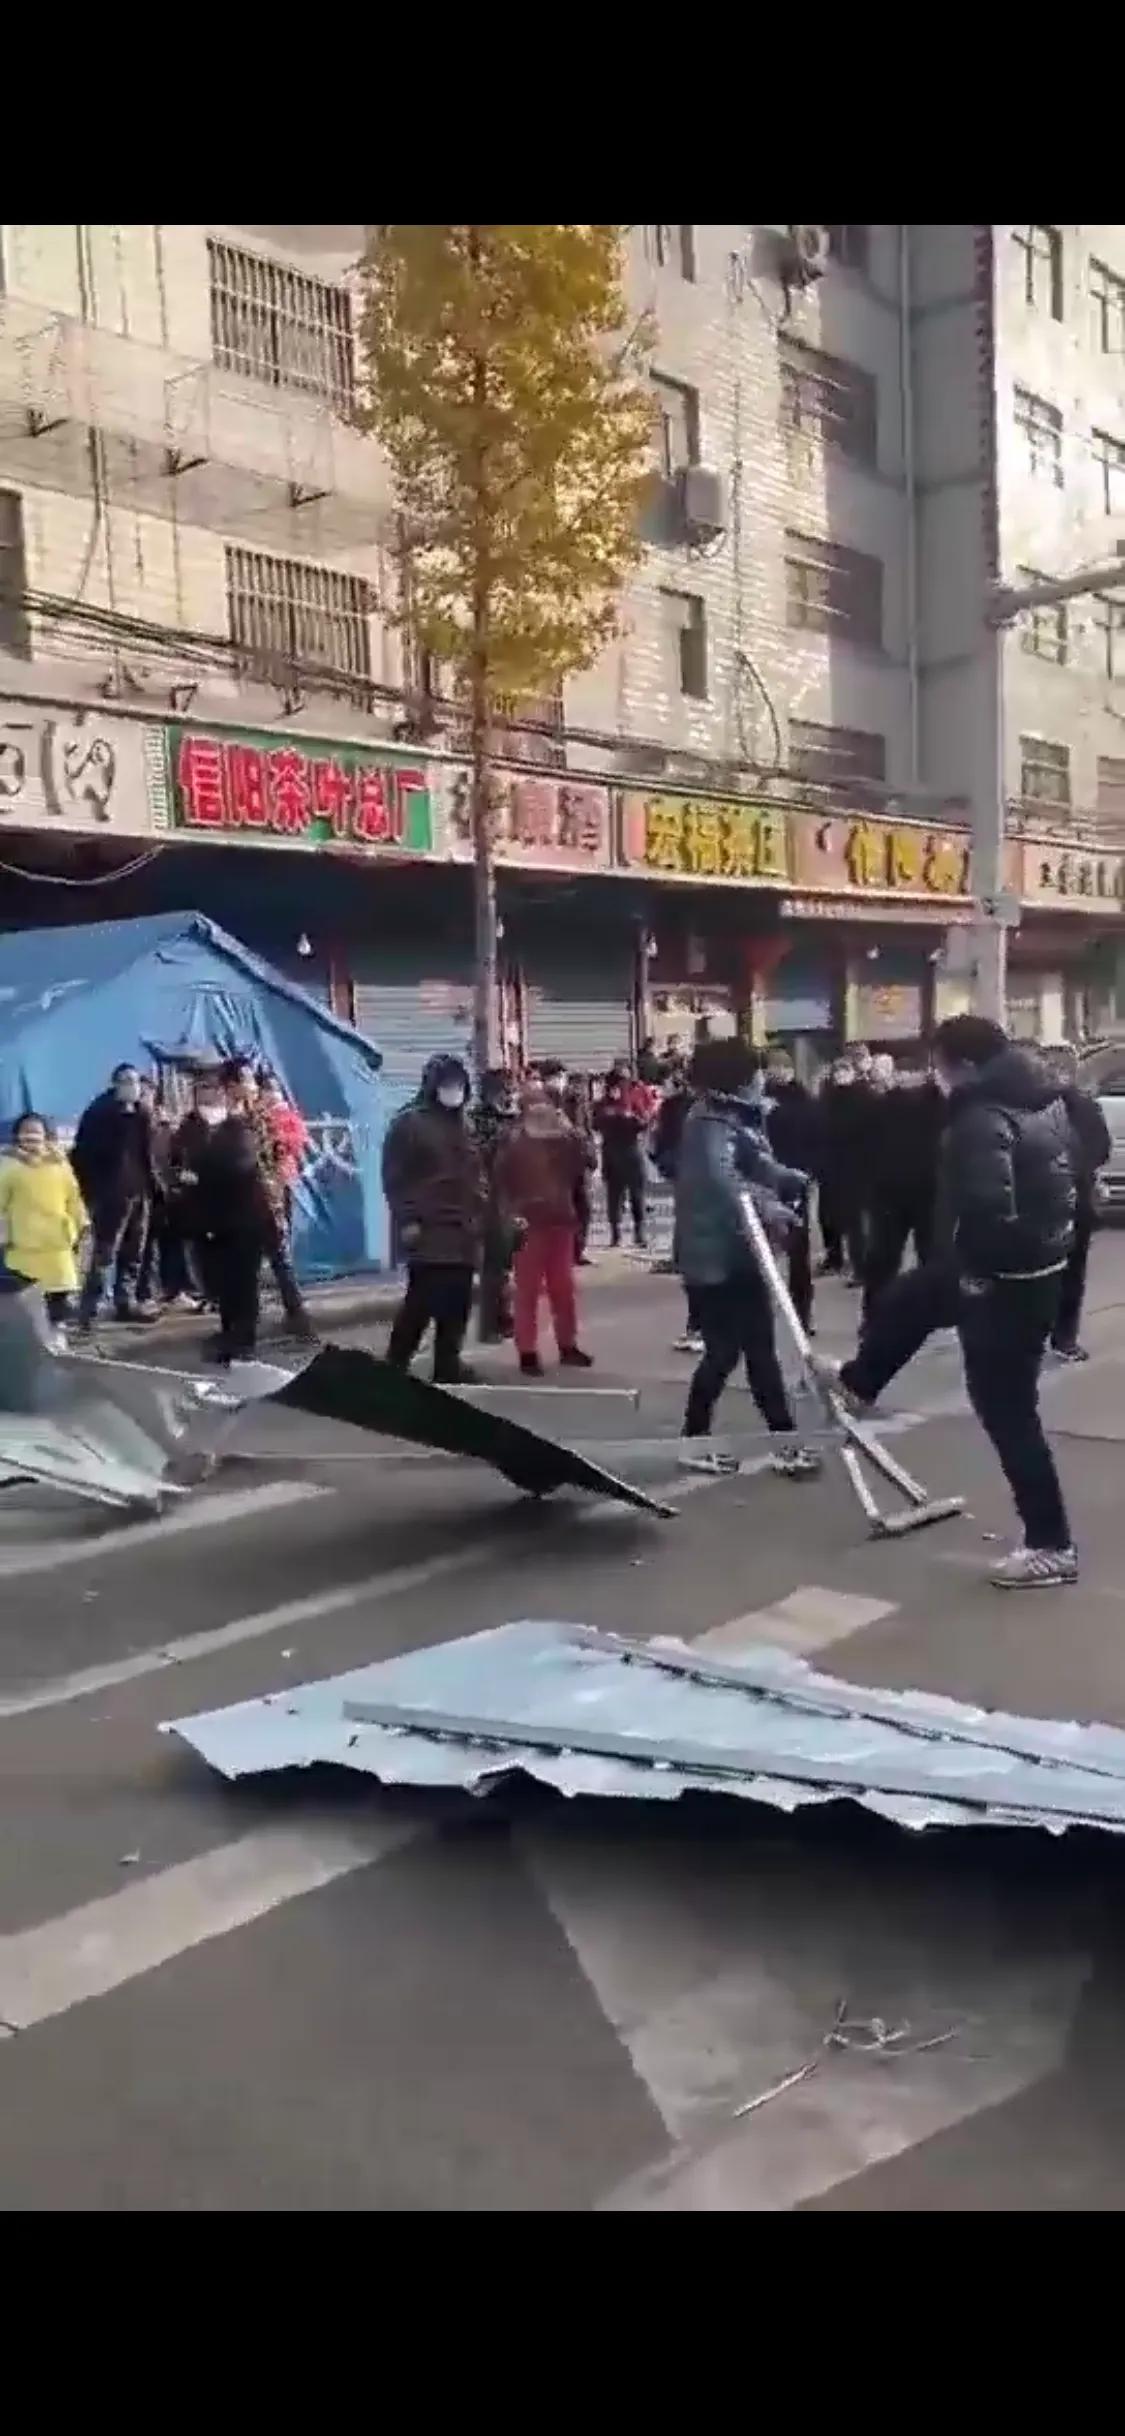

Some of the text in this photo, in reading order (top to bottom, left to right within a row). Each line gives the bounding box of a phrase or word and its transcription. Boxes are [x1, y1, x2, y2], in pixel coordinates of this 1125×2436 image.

[178, 734, 428, 846] 信阳茶叶总厂
